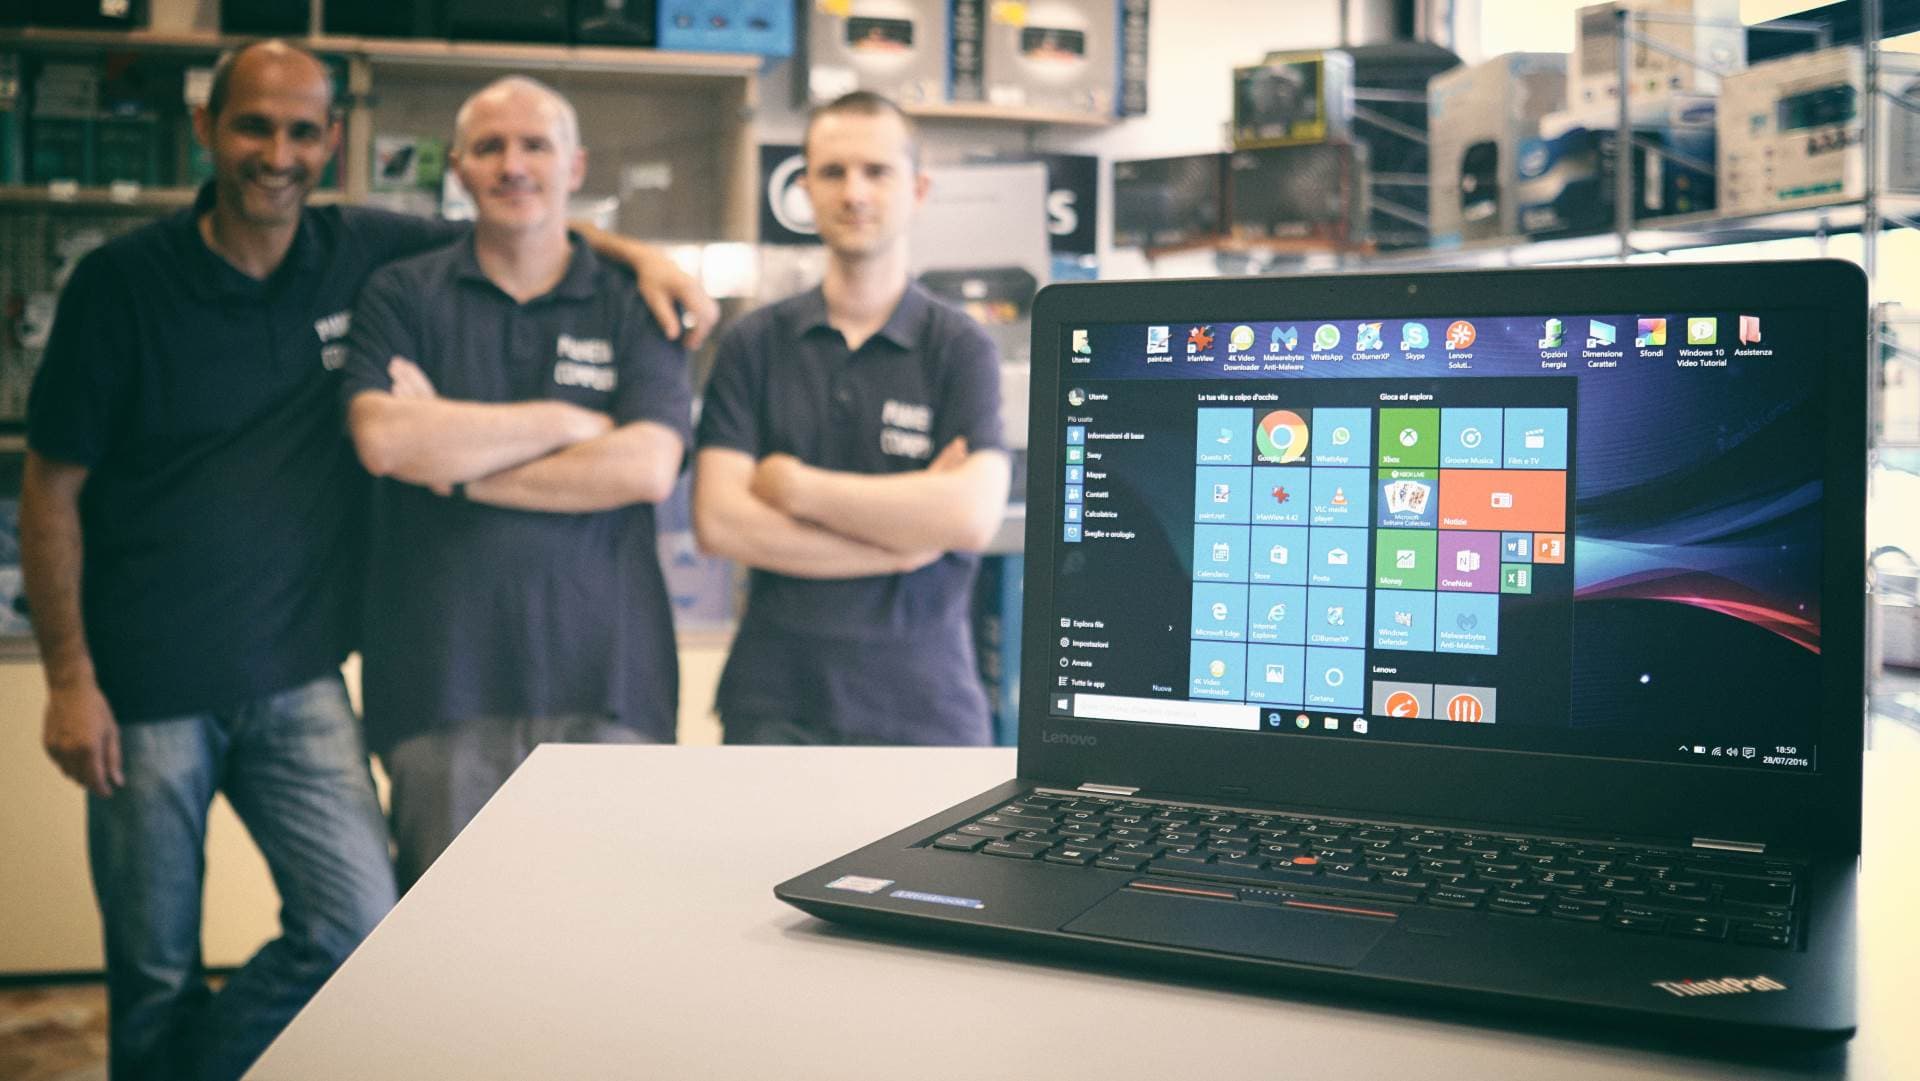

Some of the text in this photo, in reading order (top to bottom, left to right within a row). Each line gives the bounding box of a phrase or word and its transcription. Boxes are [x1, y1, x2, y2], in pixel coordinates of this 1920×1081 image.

[1263, 352, 1305, 362] Malwarebytes
[1311, 352, 1343, 362] WhatsApp
[1352, 352, 1391, 361] CDBurnerXP
[1405, 352, 1425, 361] Skype
[1448, 352, 1473, 360] Lenovo
[1541, 351, 1568, 360] Opzioni
[1582, 350, 1623, 358] Dimensione
[1640, 349, 1663, 357] Sfondi
[1679, 349, 1725, 357] Windows 10
[1147, 356, 1173, 365] paint.net
[1228, 354, 1256, 362] 4K Video
[1223, 363, 1260, 371] Downloader
[1263, 363, 1304, 371] Anti-Malware
[1541, 361, 1567, 370] Energia
[1588, 360, 1617, 368] Caratteri
[1677, 359, 1727, 367] Video Tutorial
[1198, 393, 1205, 401] La
[1217, 393, 1227, 401] vita
[1234, 393, 1251, 404] colpo
[1379, 393, 1398, 401] Gioca
[1409, 394, 1433, 404] esplora
[1087, 432, 1122, 440] Informazioni
[1123, 432, 1130, 440] di
[1086, 452, 1102, 461] Sway
[1316, 455, 1349, 465] WhatsApp
[1383, 455, 1400, 463] Xbox
[1444, 457, 1494, 465] Groove Musica
[1508, 457, 1523, 465] Film
[1086, 472, 1107, 481] Mappe
[1084, 511, 1118, 519] Calcolatrice
[1314, 515, 1333, 523] player
[1443, 518, 1467, 526] Notizie
[1197, 570, 1229, 578] Calendario
[1254, 572, 1271, 580] Store
[1379, 577, 1403, 587] Money
[1441, 579, 1472, 588] OneNote
[1094, 620, 1104, 629] file
[1224, 629, 1241, 638] Edge
[1252, 631, 1278, 640] Explorer
[1378, 628, 1408, 637] Windows
[1440, 631, 1486, 641] Malwarebytes
[1072, 640, 1109, 650] Impostazioni
[1378, 638, 1408, 646] Defender
[1372, 665, 1397, 674] Lenovo
[1093, 682, 1105, 690] app
[1251, 690, 1265, 698] Foto
[1309, 695, 1334, 703] Cortana
[1042, 730, 1097, 745] Lenovo
[1775, 746, 1797, 754] 18:50
[1762, 756, 1808, 766] 28/07/2016
[1650, 975, 1787, 997] ThinkPad
